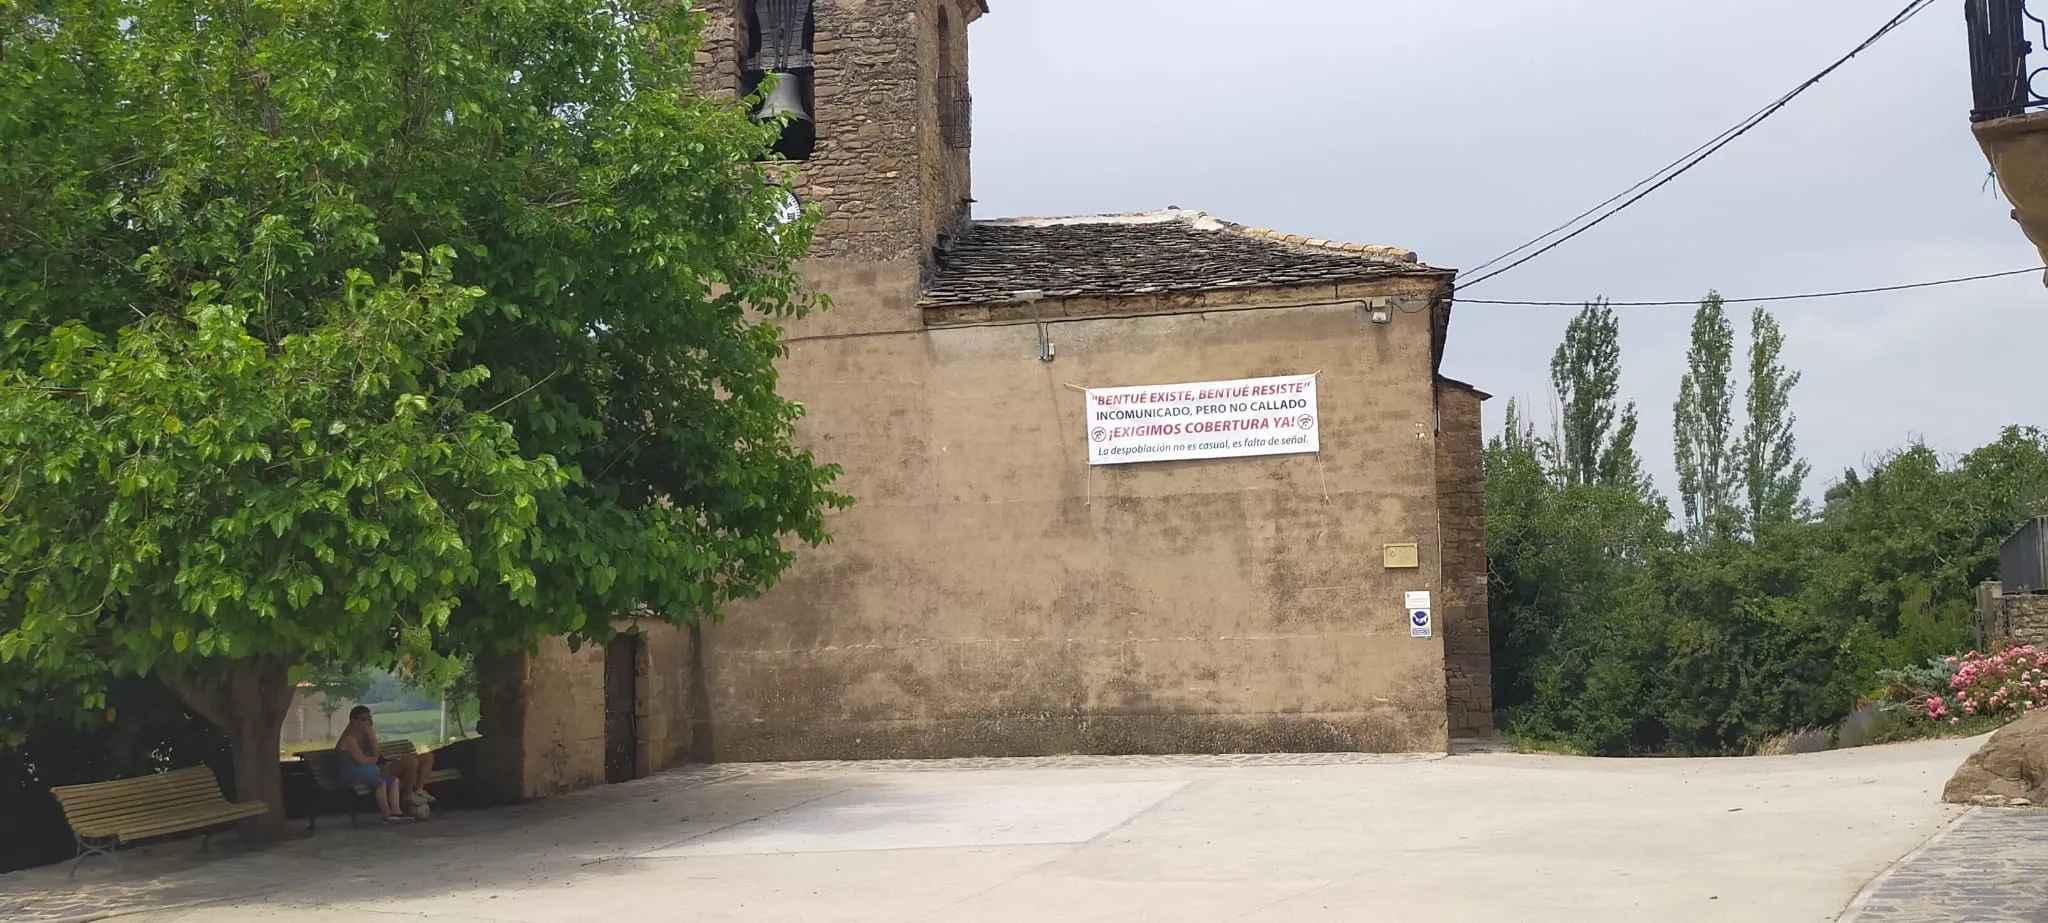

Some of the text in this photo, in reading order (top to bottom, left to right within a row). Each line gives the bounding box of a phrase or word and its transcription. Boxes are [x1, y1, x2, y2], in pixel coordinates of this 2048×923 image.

[1149, 391, 1195, 403] EXISTE,
[1198, 384, 1249, 400] BENTUÉ
[1096, 398, 1307, 420] INCOMUNICADO, PERO NO CALLADO
[1109, 416, 1295, 441] ¡EXIGIMOS COBERTURA YA!
[1098, 434, 1308, 456] La despoblación no es casual, es falta de señal.
